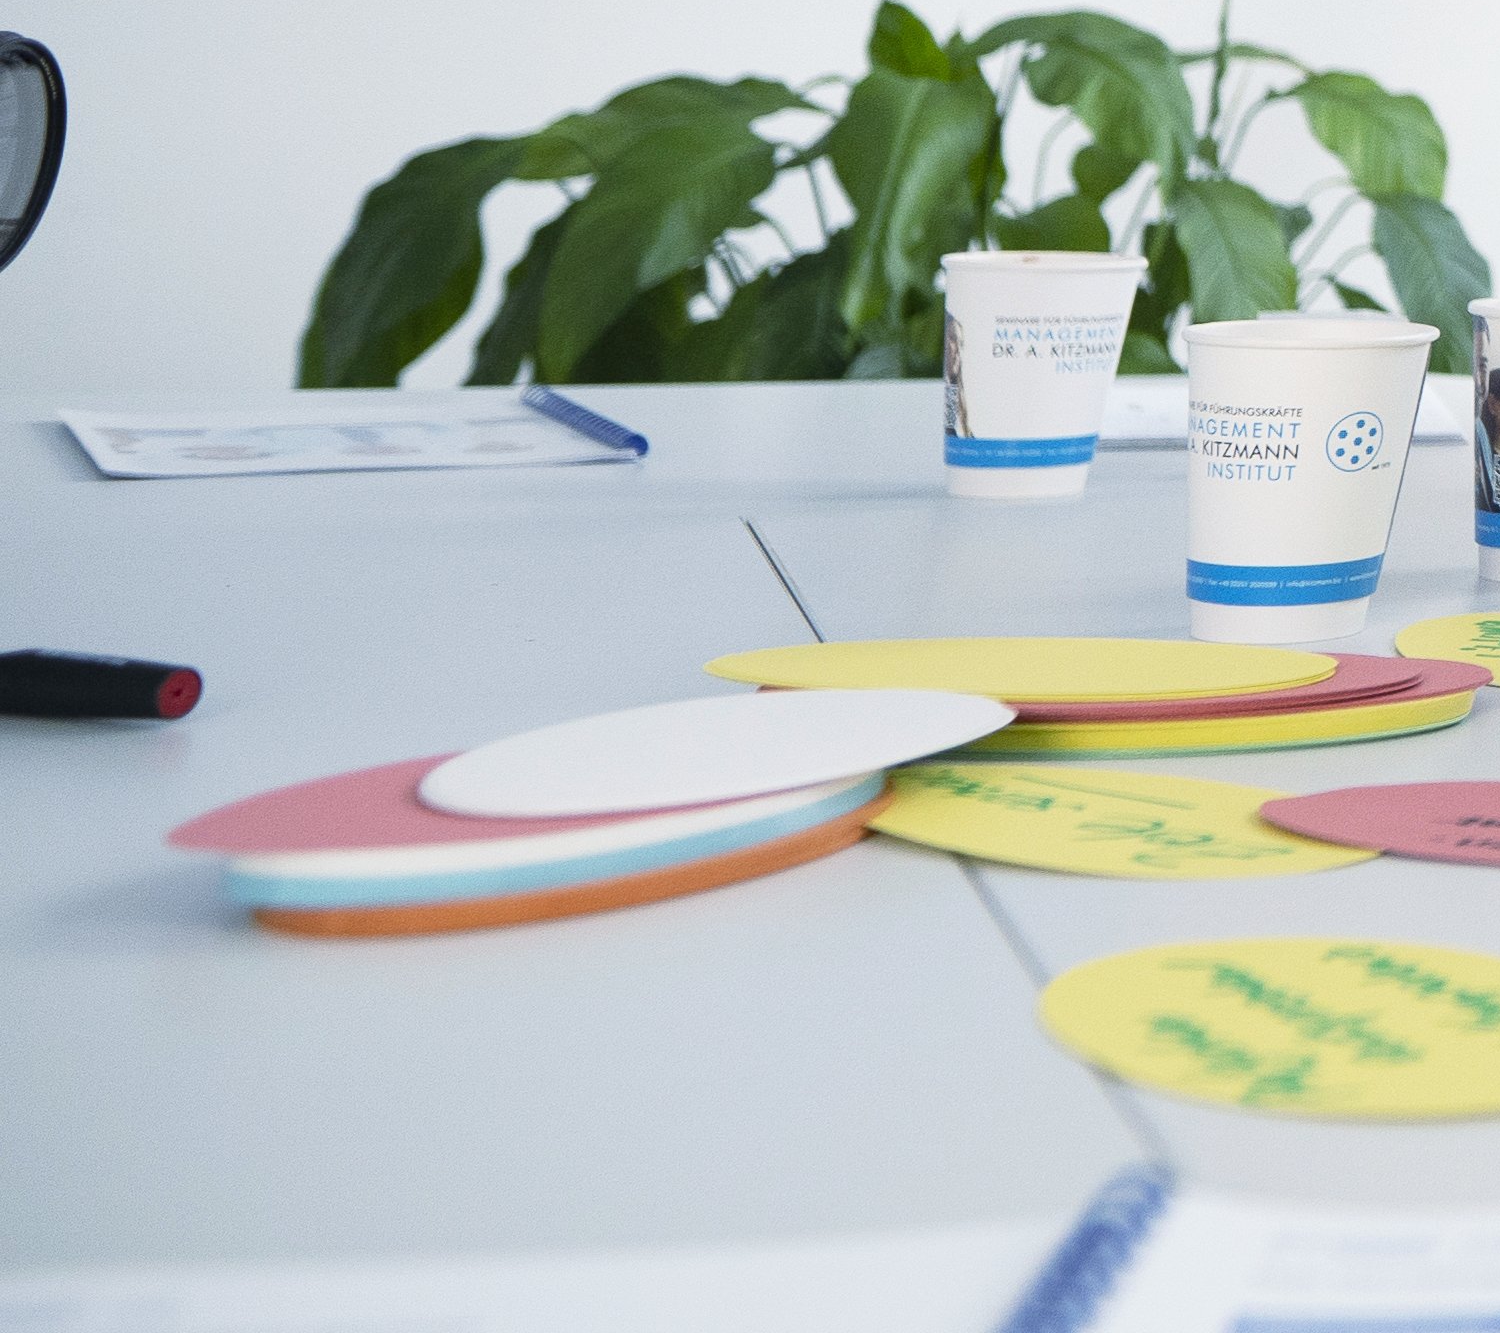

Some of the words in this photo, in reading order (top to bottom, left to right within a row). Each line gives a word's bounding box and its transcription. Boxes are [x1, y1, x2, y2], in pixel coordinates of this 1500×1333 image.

[991, 343, 1019, 359] DR.
[1026, 344, 1043, 359] A.
[1209, 402, 1304, 418] FÜHRUNGSKRÄFTE
[1202, 440, 1300, 460] KITZMANN
[1207, 463, 1297, 482] INSTITUT
